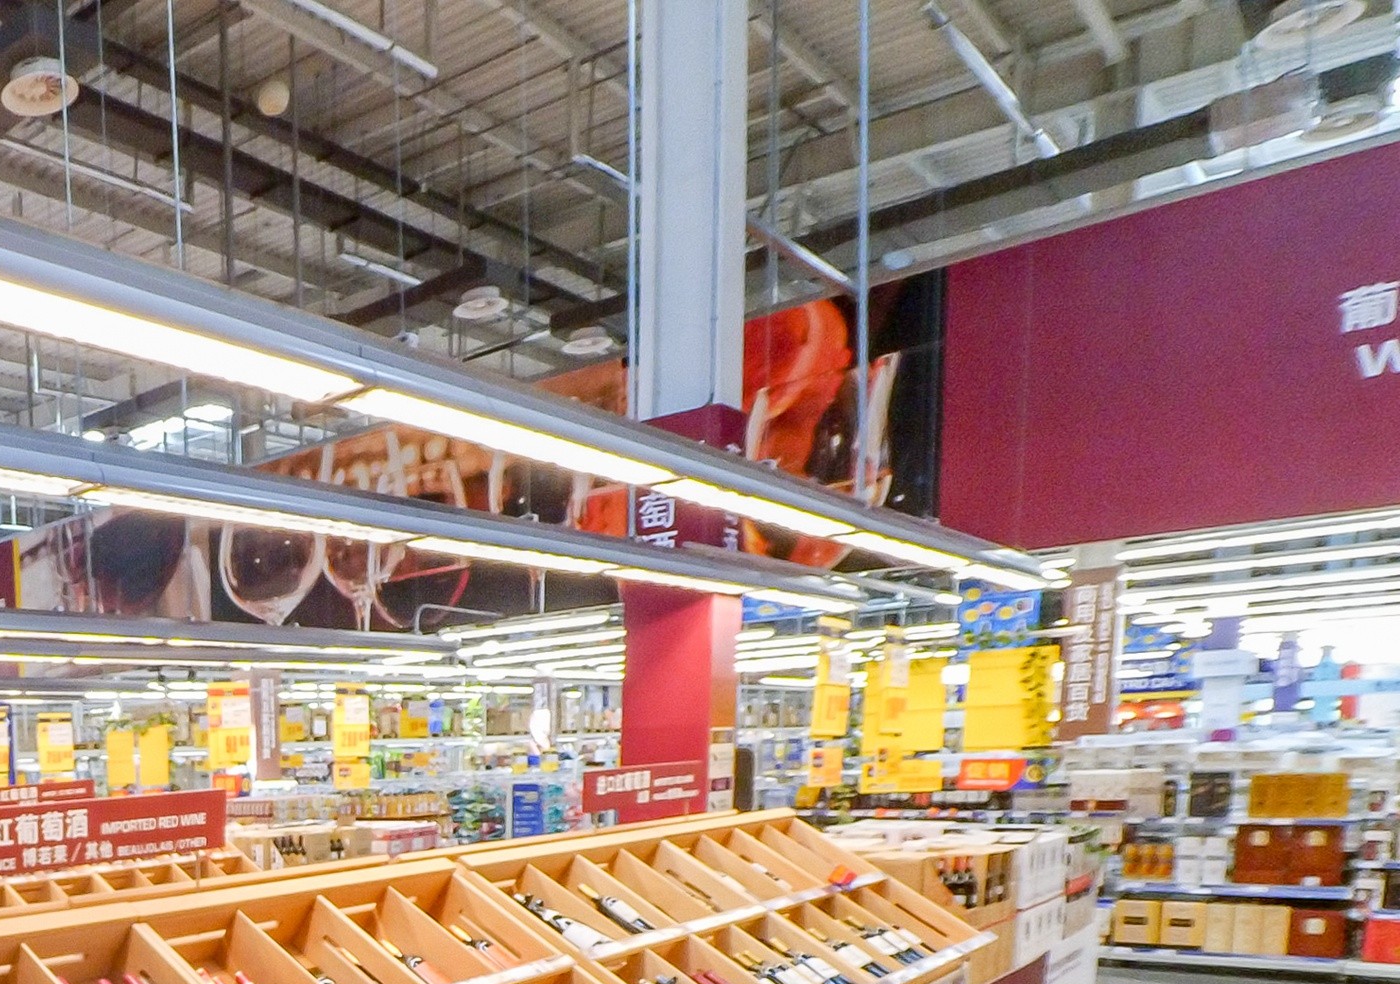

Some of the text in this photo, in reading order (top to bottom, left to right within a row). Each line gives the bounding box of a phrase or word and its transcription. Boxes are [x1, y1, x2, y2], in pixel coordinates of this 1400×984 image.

[101, 812, 207, 835] IMPORTED RED WINE
